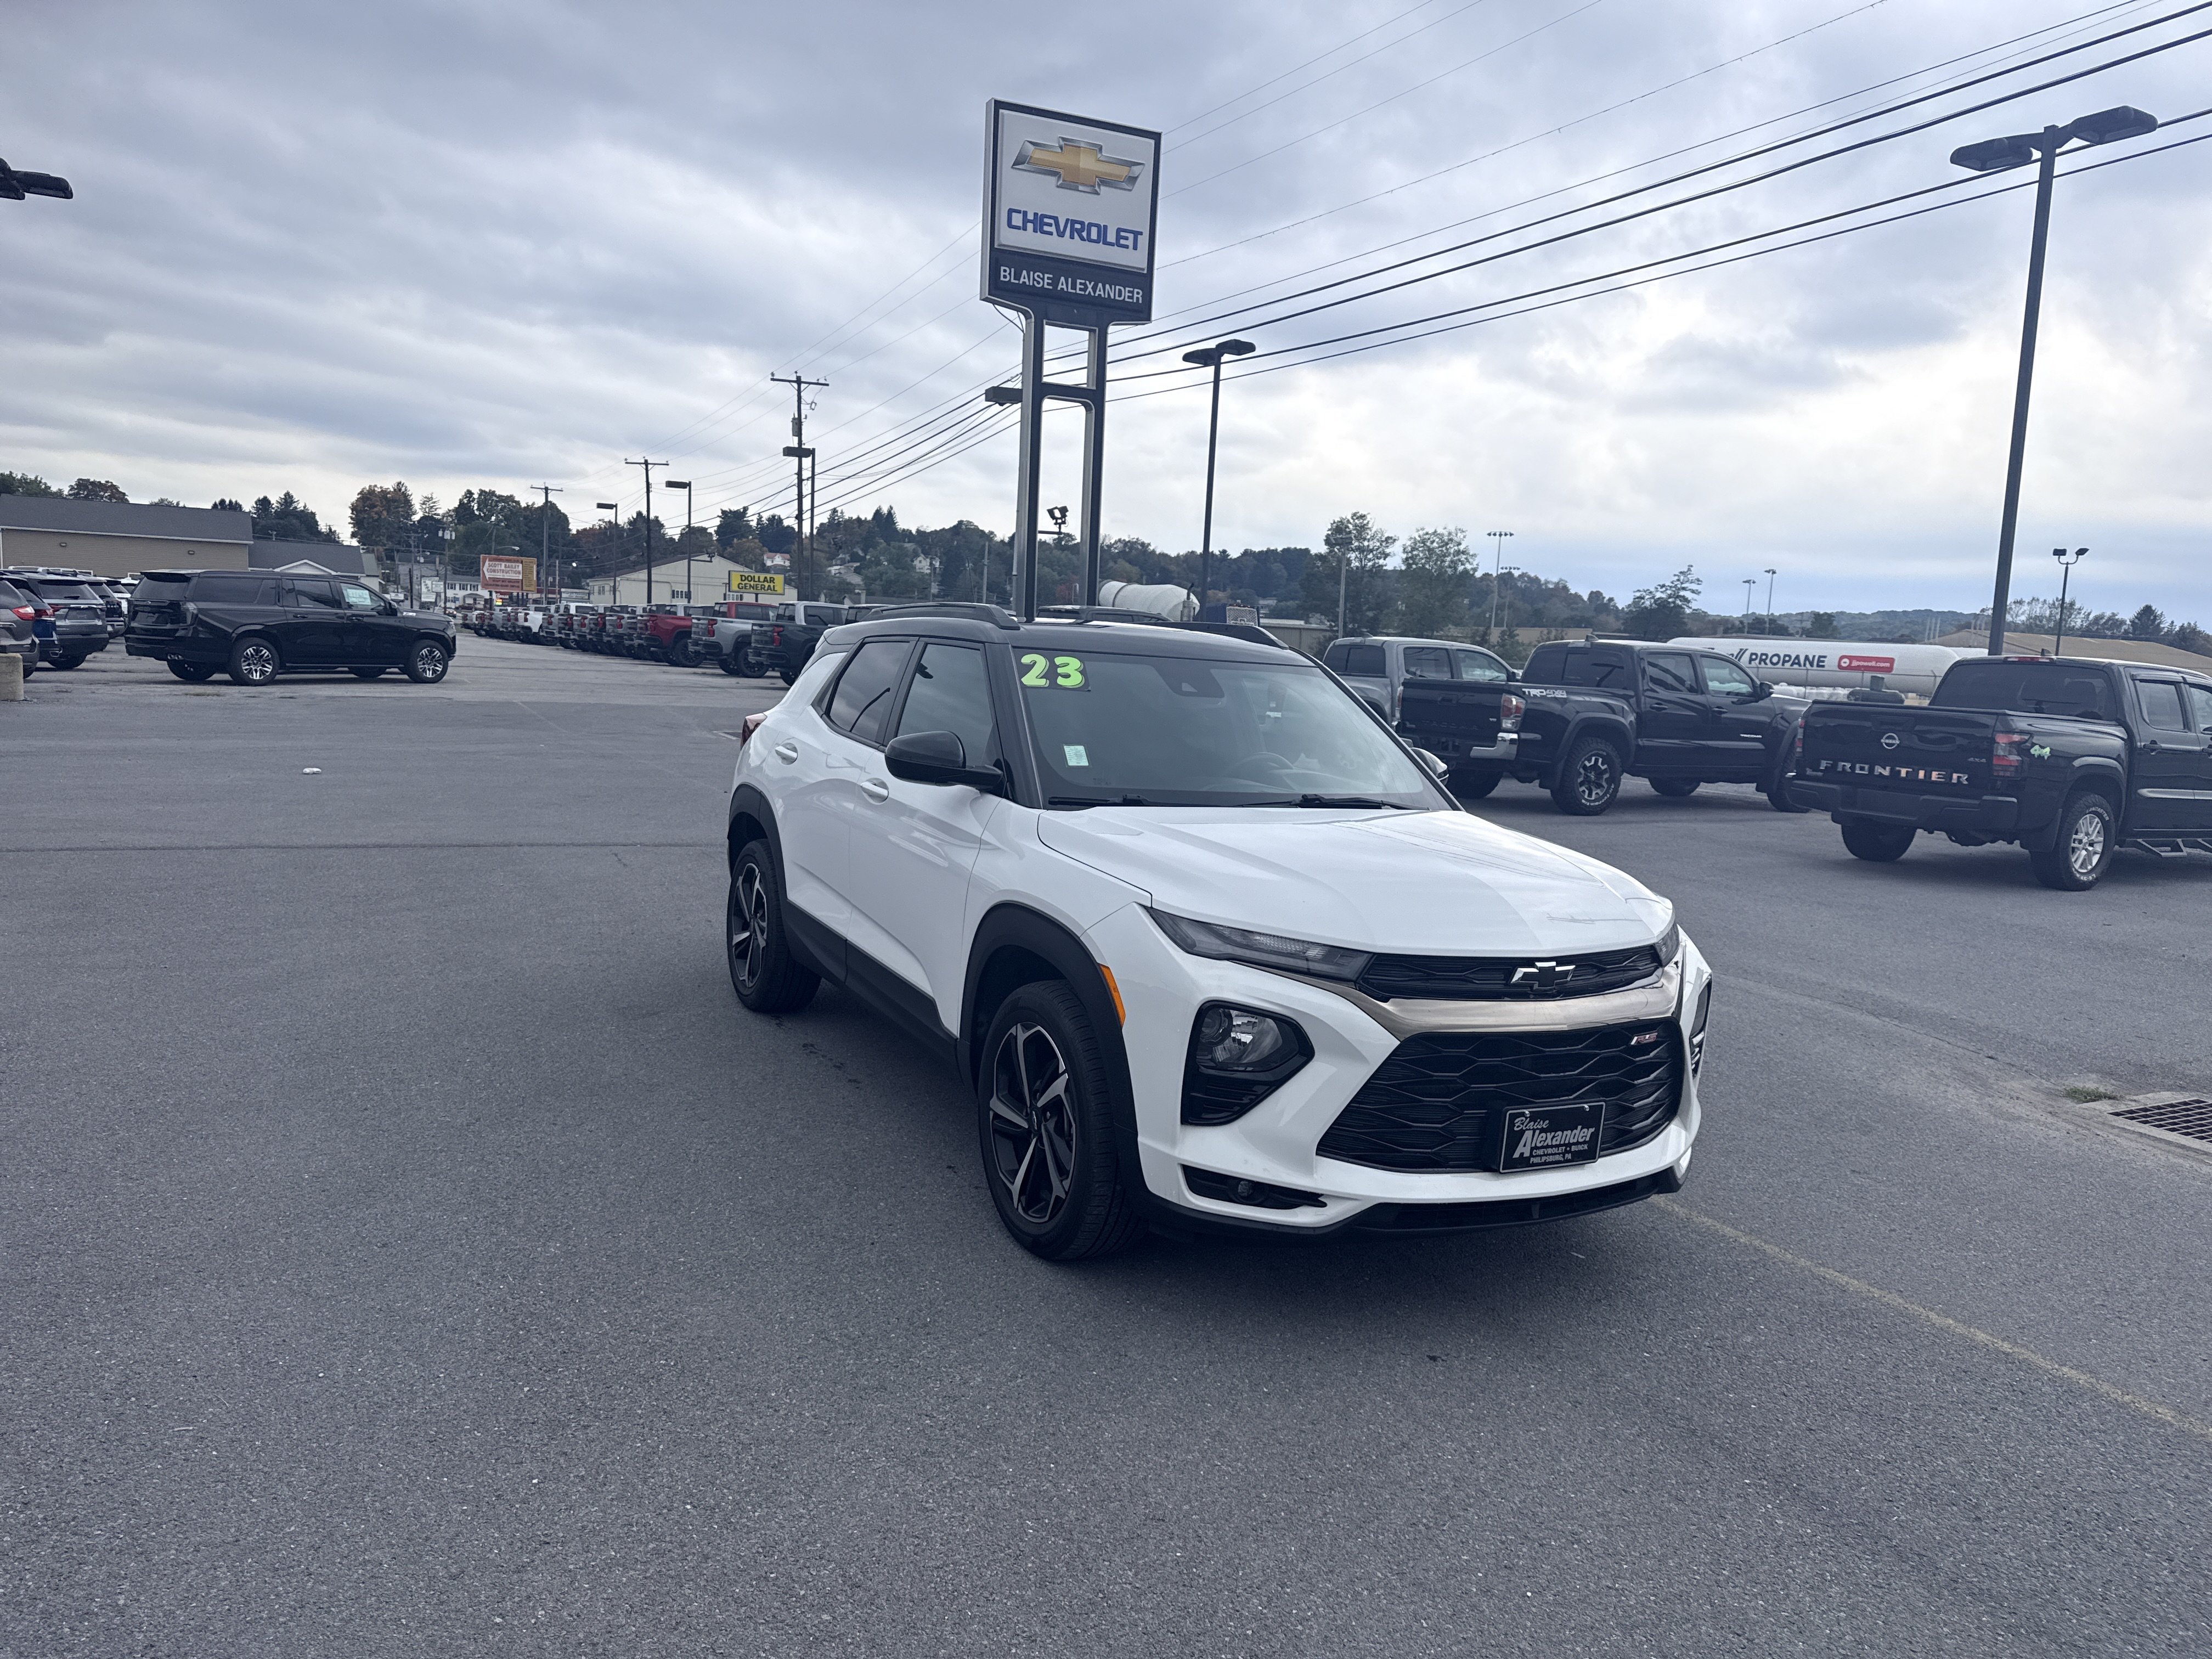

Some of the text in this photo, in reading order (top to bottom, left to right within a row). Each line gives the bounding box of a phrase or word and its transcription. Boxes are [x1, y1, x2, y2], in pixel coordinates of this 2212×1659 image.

[1007, 208, 1143, 250] CHEVROLET
[1000, 266, 1143, 303] BLAISE ALEXANDER
[737, 583, 777, 591] GENERAL
[740, 574, 775, 584] DOLLAR
[1748, 652, 1827, 668] PROPANE
[1021, 653, 1085, 687] 23
[1820, 760, 1969, 784] FRONTIER
[1630, 1032, 1658, 1045] RS
[1514, 1117, 1549, 1131] Blaise
[1513, 1125, 1595, 1158] Alexander
[1533, 1143, 1588, 1156] CHEVROLET BUICK
